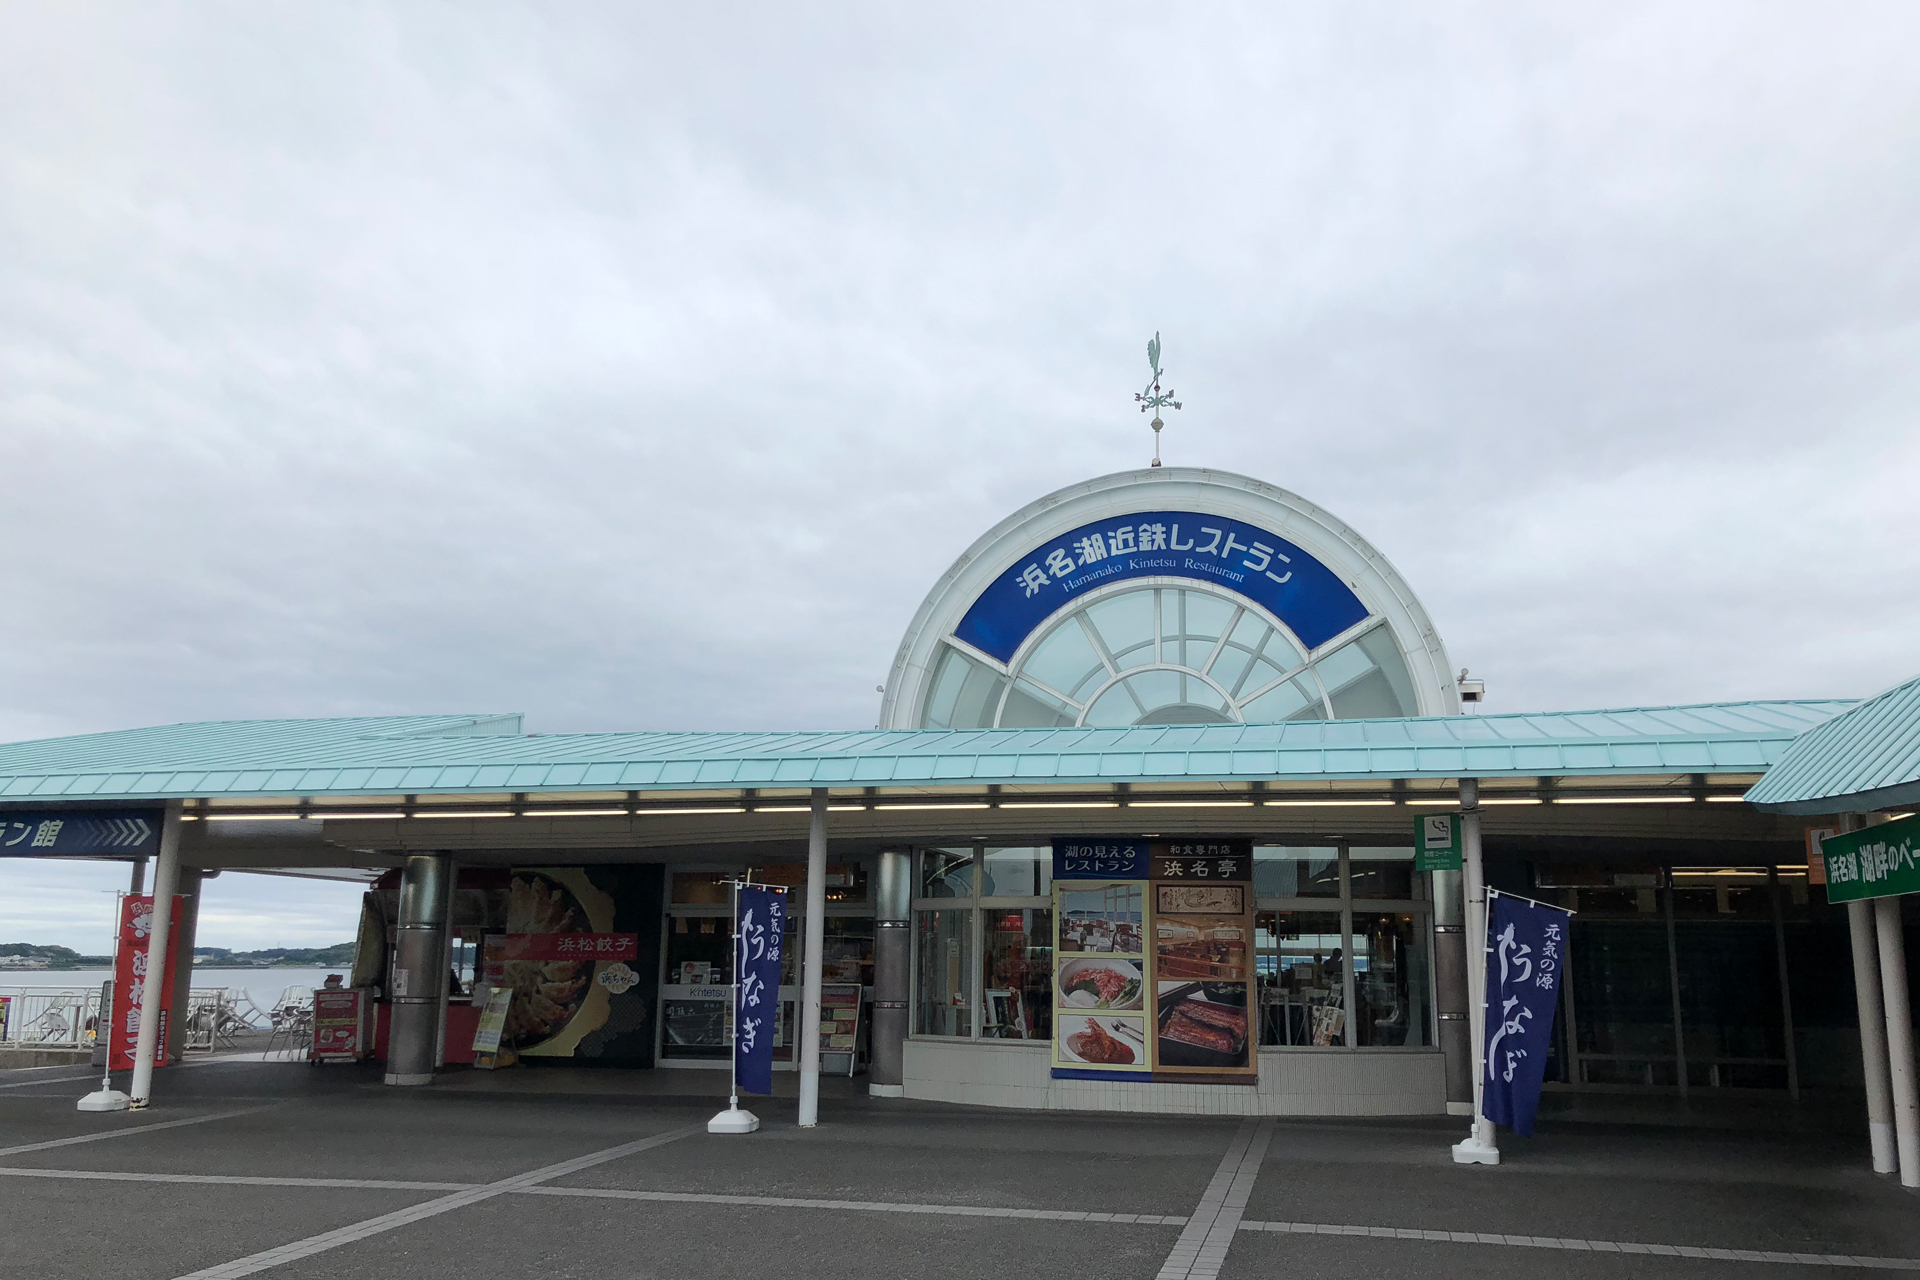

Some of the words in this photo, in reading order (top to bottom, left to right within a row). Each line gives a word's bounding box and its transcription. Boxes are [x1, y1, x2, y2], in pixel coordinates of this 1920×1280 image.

[1015, 523, 1293, 598] 浜名湖近鉄レストラン
[1062, 563, 1123, 592] Hamanako
[1129, 558, 1176, 570] Kintetsu
[1184, 558, 1245, 583] Restaurant
[1064, 845, 1136, 858] 湖の見える
[1064, 860, 1135, 871] レストラン
[1170, 845, 1231, 855] 和食専門店
[1163, 859, 1237, 878] 浜名亭
[1828, 852, 1858, 884] 浜名湖
[557, 937, 634, 952] 浜松餃子
[767, 902, 782, 961] 元気の源
[1536, 923, 1561, 990] 元気の源
[601, 972, 637, 984] 浜ちゃん
[741, 922, 765, 1053] うなぎ
[1496, 942, 1533, 1084] うなぎ
